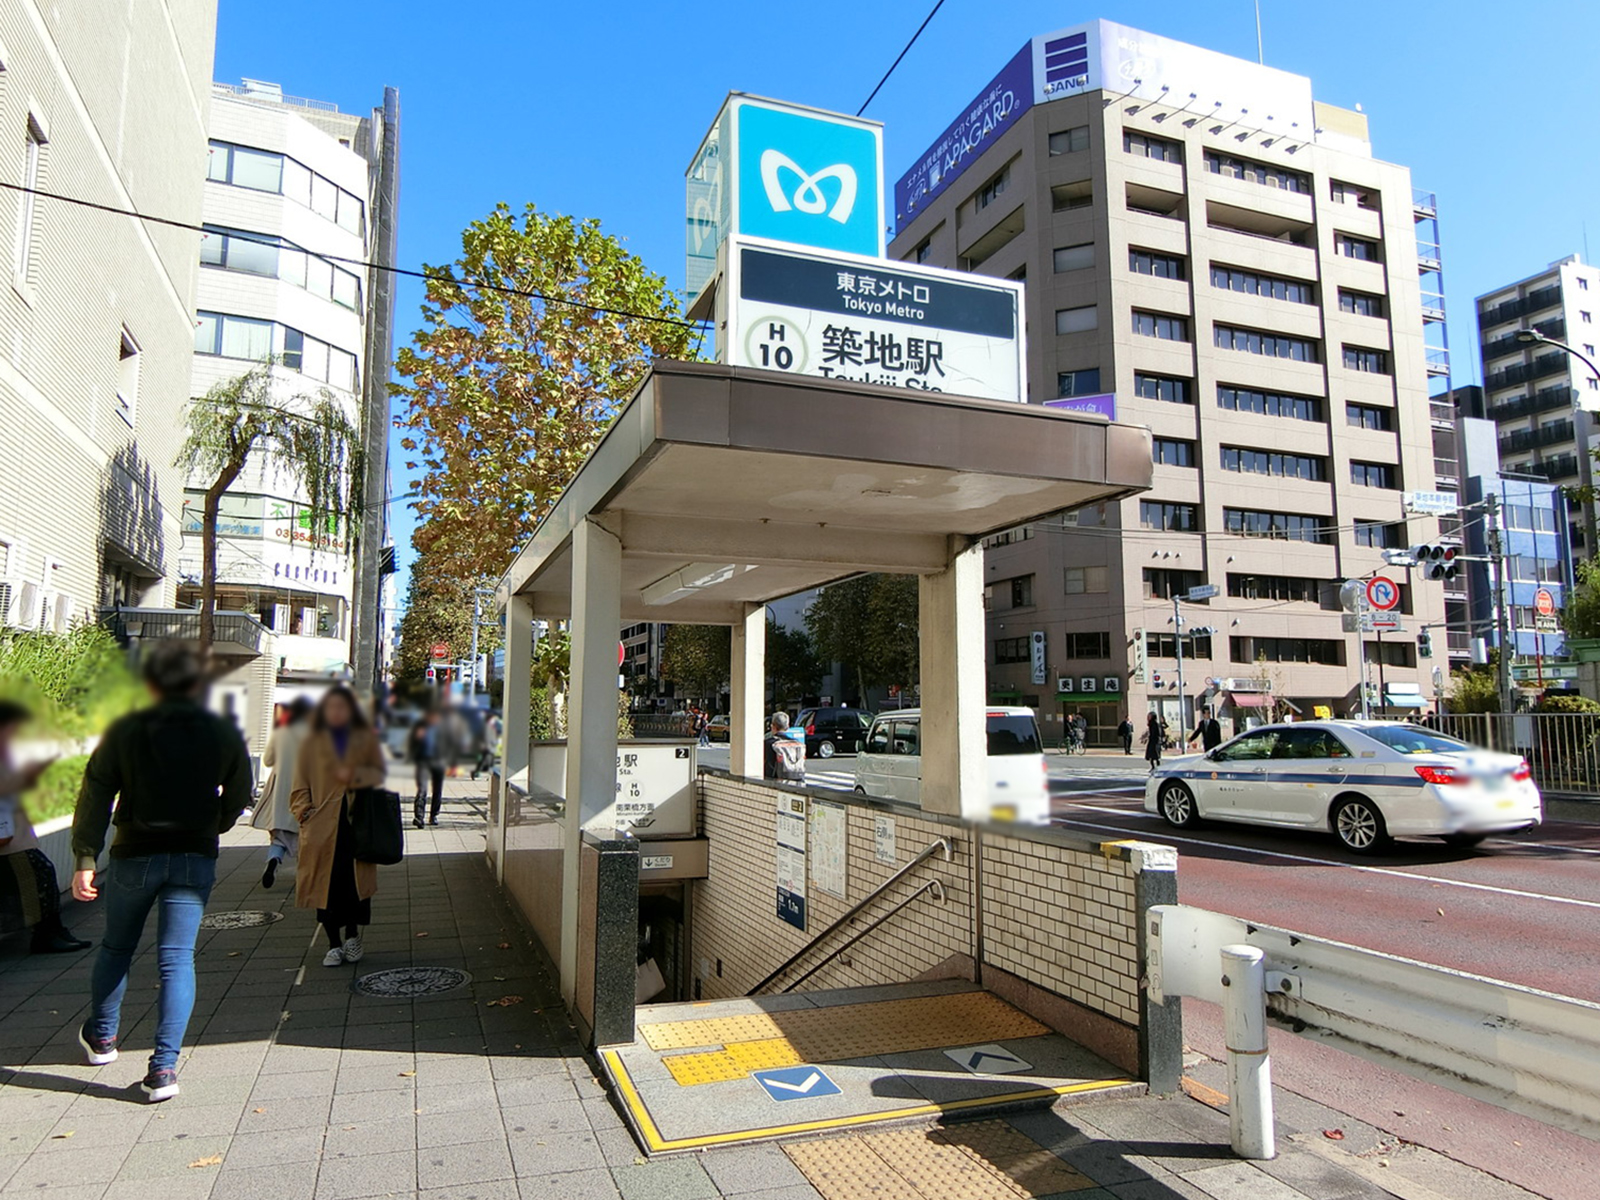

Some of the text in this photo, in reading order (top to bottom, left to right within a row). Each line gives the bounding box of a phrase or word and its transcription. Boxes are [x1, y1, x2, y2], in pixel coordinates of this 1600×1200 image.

[836, 271, 930, 304] 東京メトロ
[843, 295, 925, 320] Tokyo Metro
[769, 323, 785, 341] H
[760, 343, 793, 370] 10
[822, 323, 946, 378] 築地駅
[679, 749, 685, 758] 2
[629, 789, 640, 797] 10
